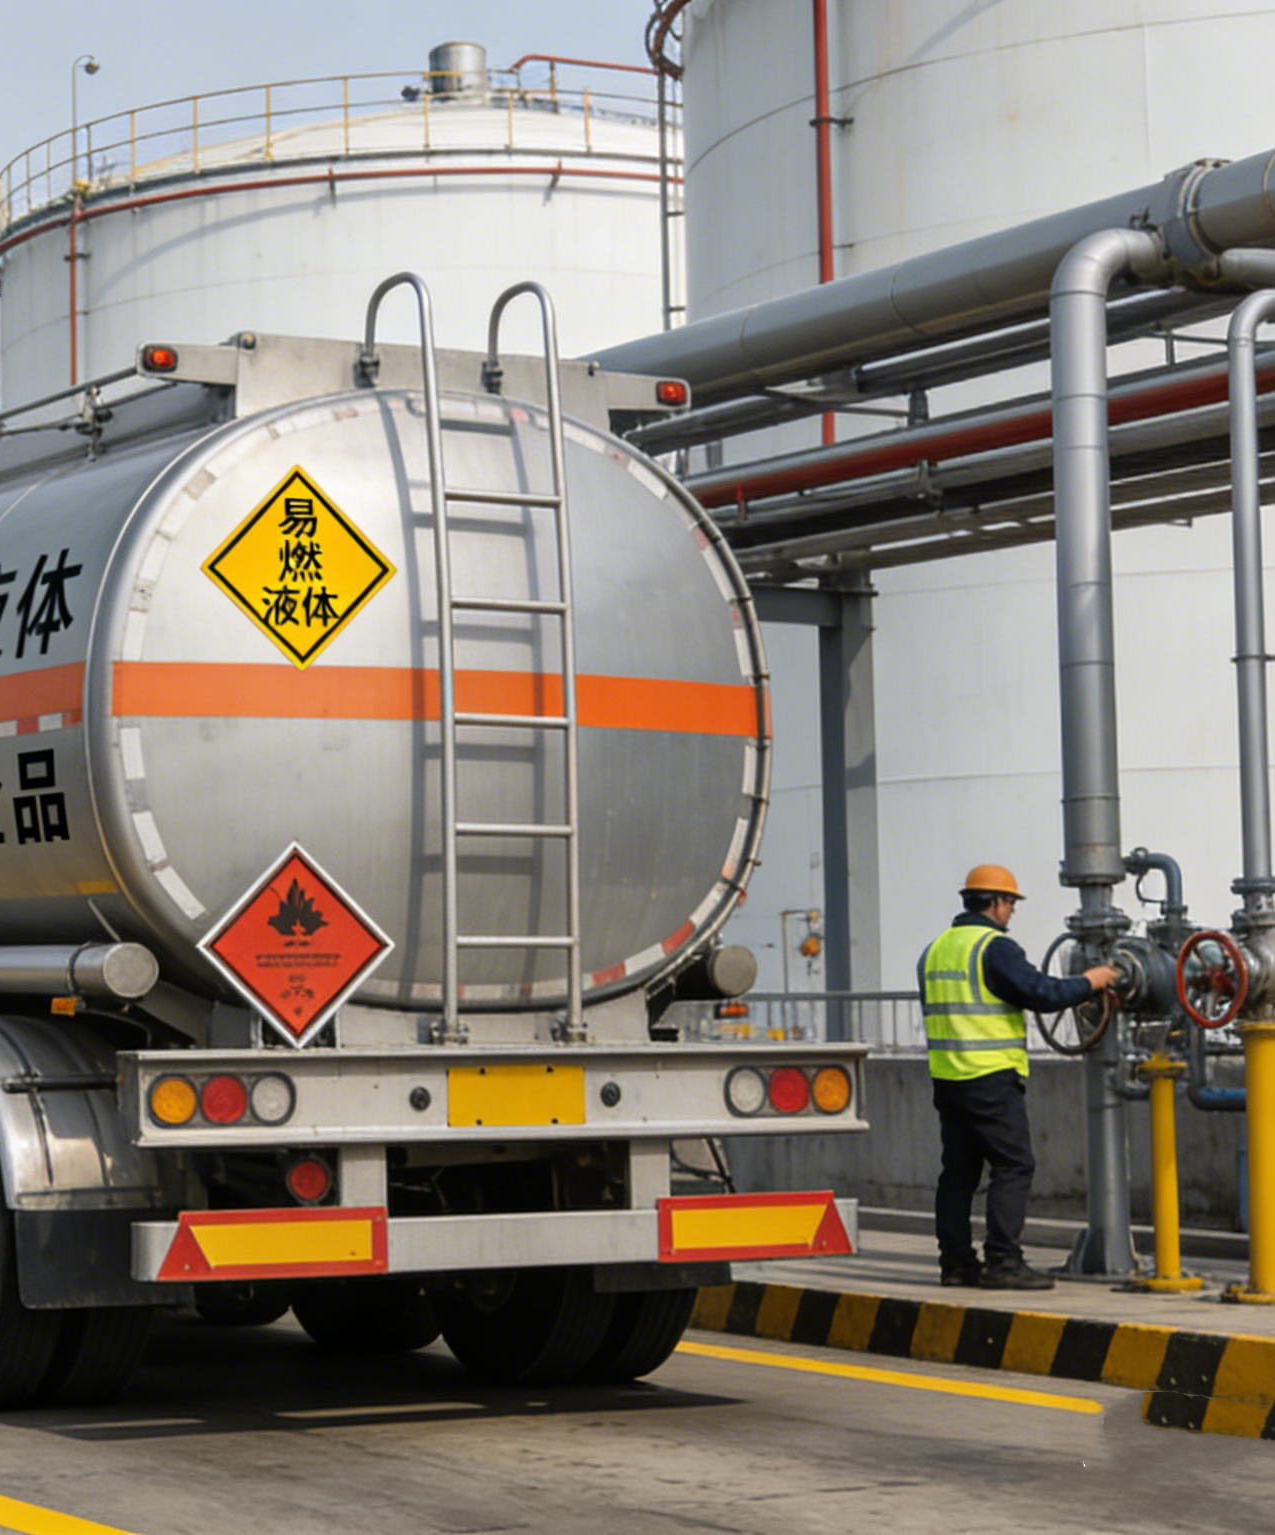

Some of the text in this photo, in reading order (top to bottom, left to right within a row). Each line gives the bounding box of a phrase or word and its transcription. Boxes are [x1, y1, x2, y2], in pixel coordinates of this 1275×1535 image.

[279, 498, 317, 538] 易
[279, 540, 322, 582] 燃
[262, 585, 340, 627] 液体
